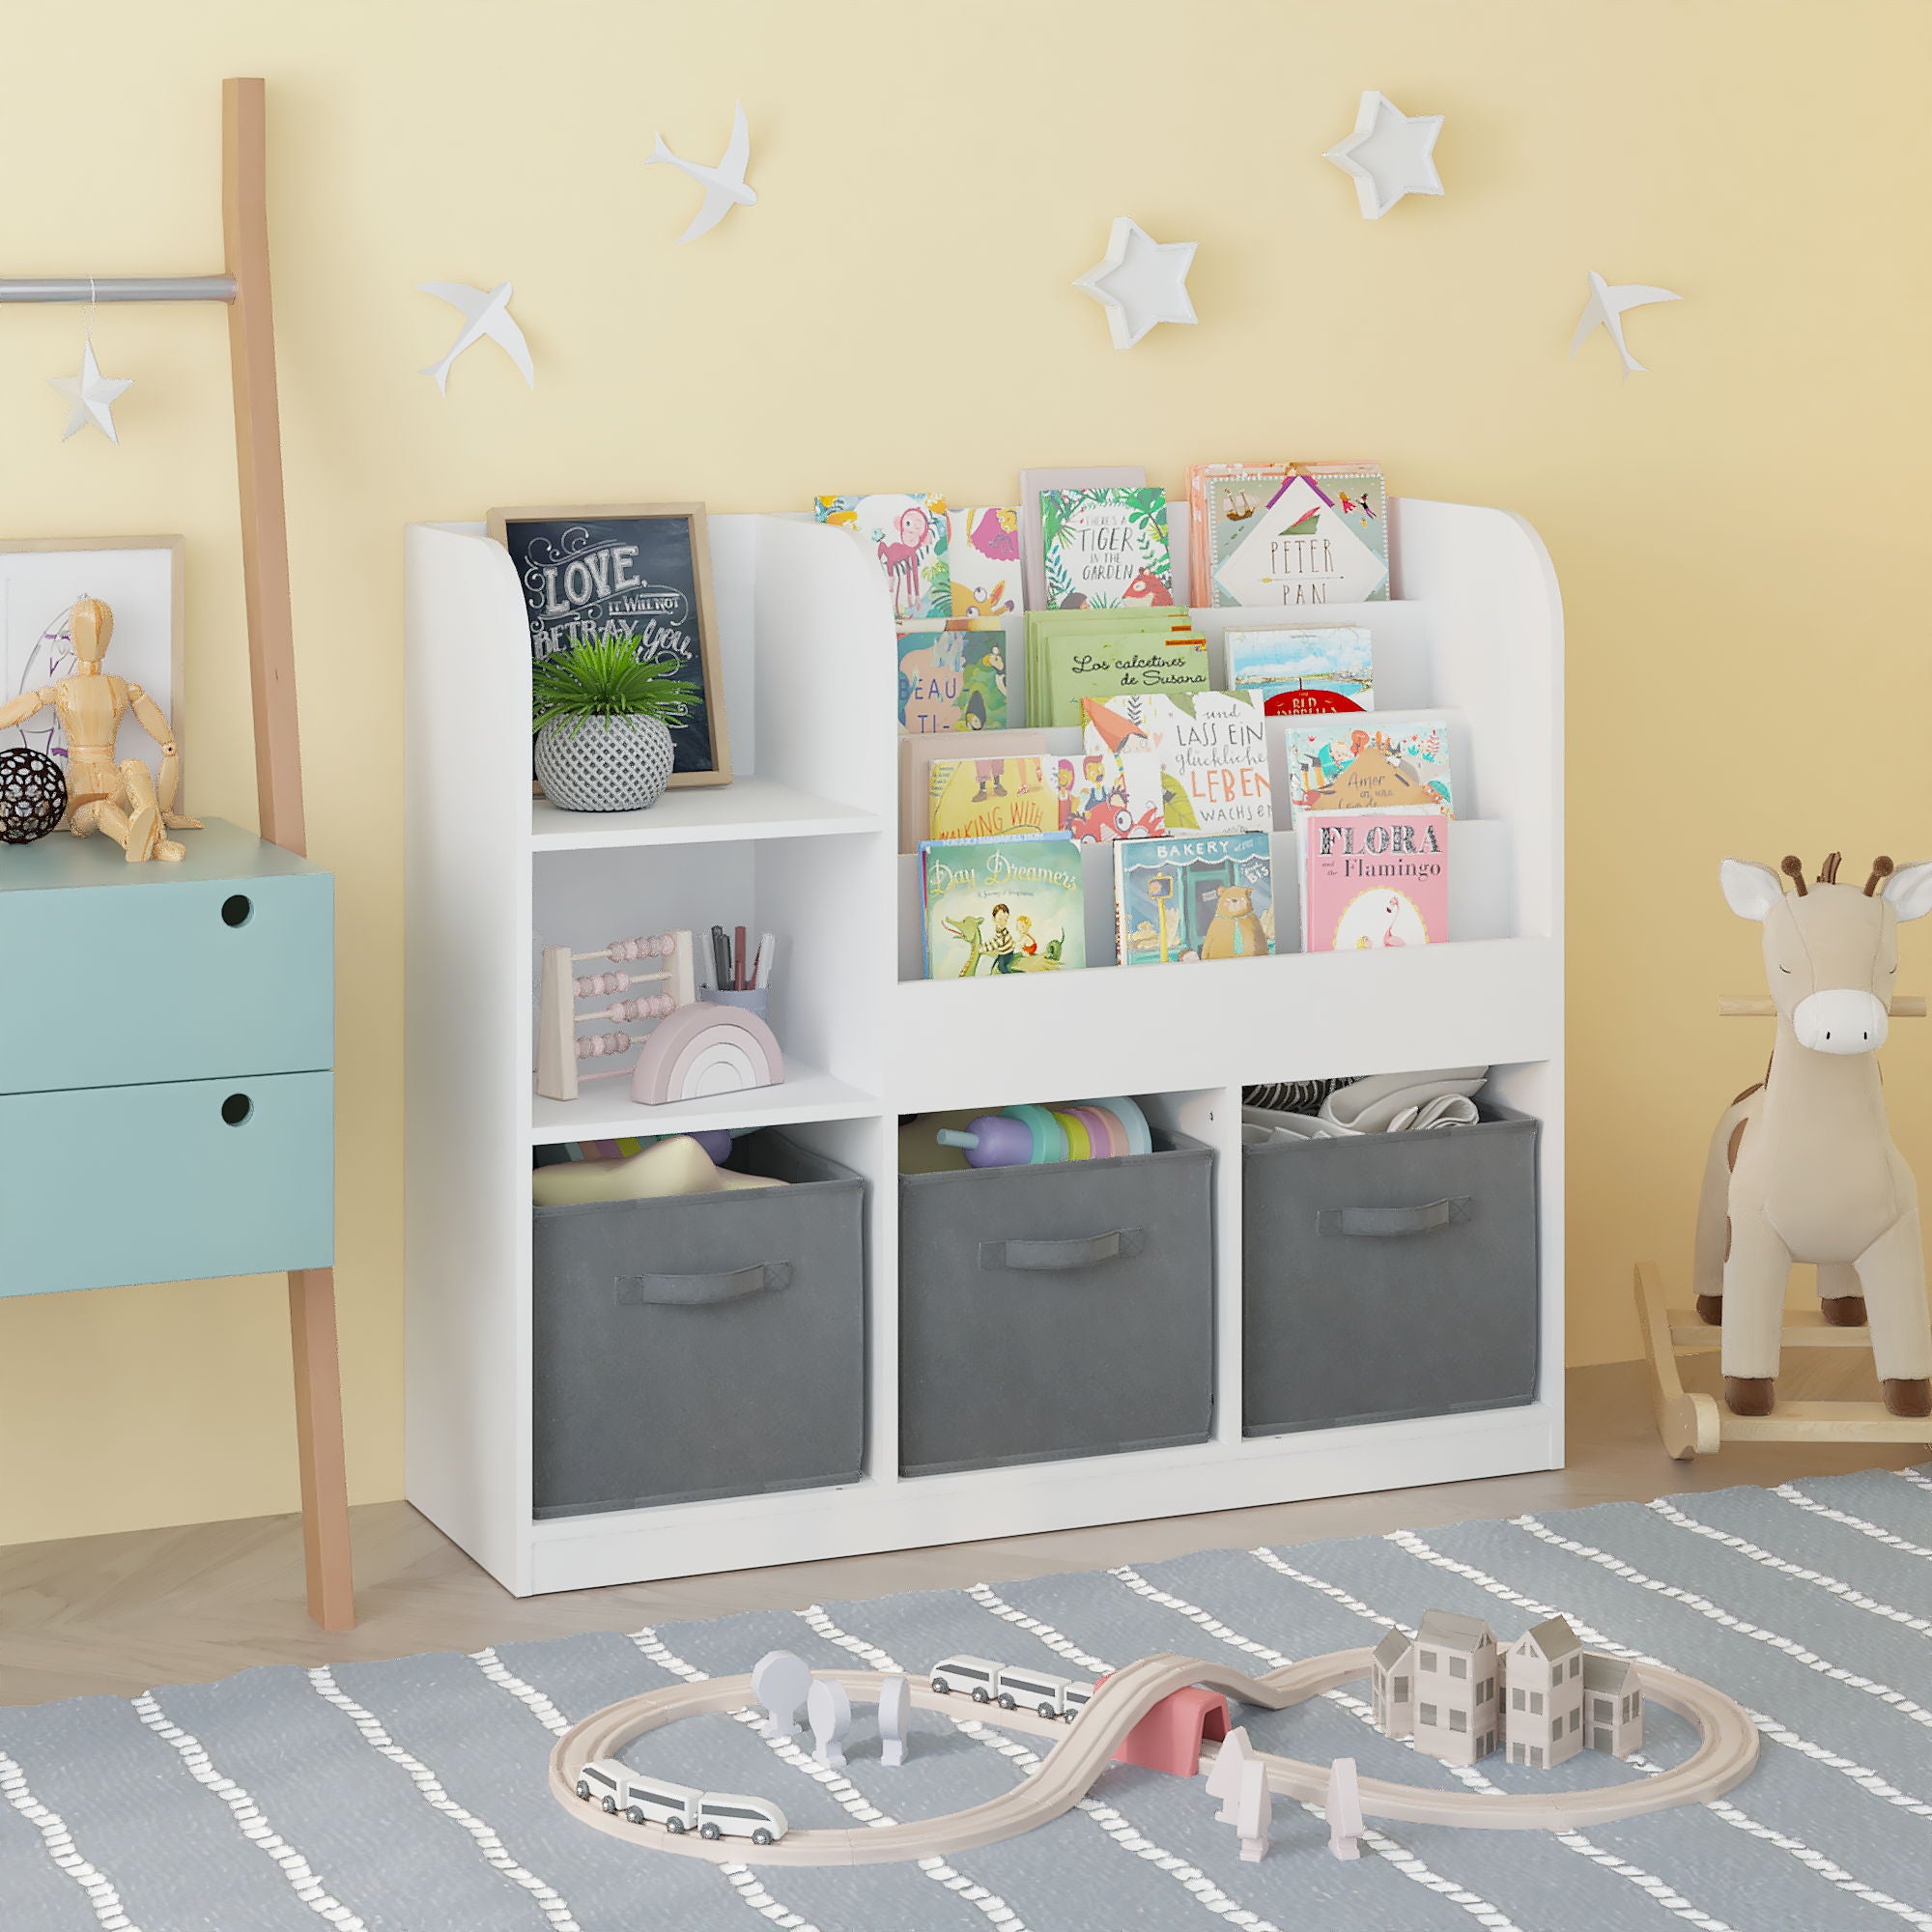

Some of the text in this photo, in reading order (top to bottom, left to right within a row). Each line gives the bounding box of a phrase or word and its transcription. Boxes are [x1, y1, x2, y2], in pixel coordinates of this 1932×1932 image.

[1077, 527, 1134, 552] TIGER
[1104, 553, 1121, 563] THE
[1270, 538, 1334, 575] PETER
[1082, 564, 1134, 581] GARDEN
[1282, 582, 1327, 605] PAN
[655, 597, 680, 614] NOT
[1072, 654, 1186, 673] Los calcetines
[1121, 669, 1207, 687] de Susana
[1203, 704, 1241, 720] und
[1176, 722, 1218, 747] LASS
[1156, 839, 1230, 859] BAKERY
[1318, 824, 1443, 857] FLORA
[930, 849, 1077, 898] Day Dreamers
[1345, 858, 1441, 882] Flamingo
